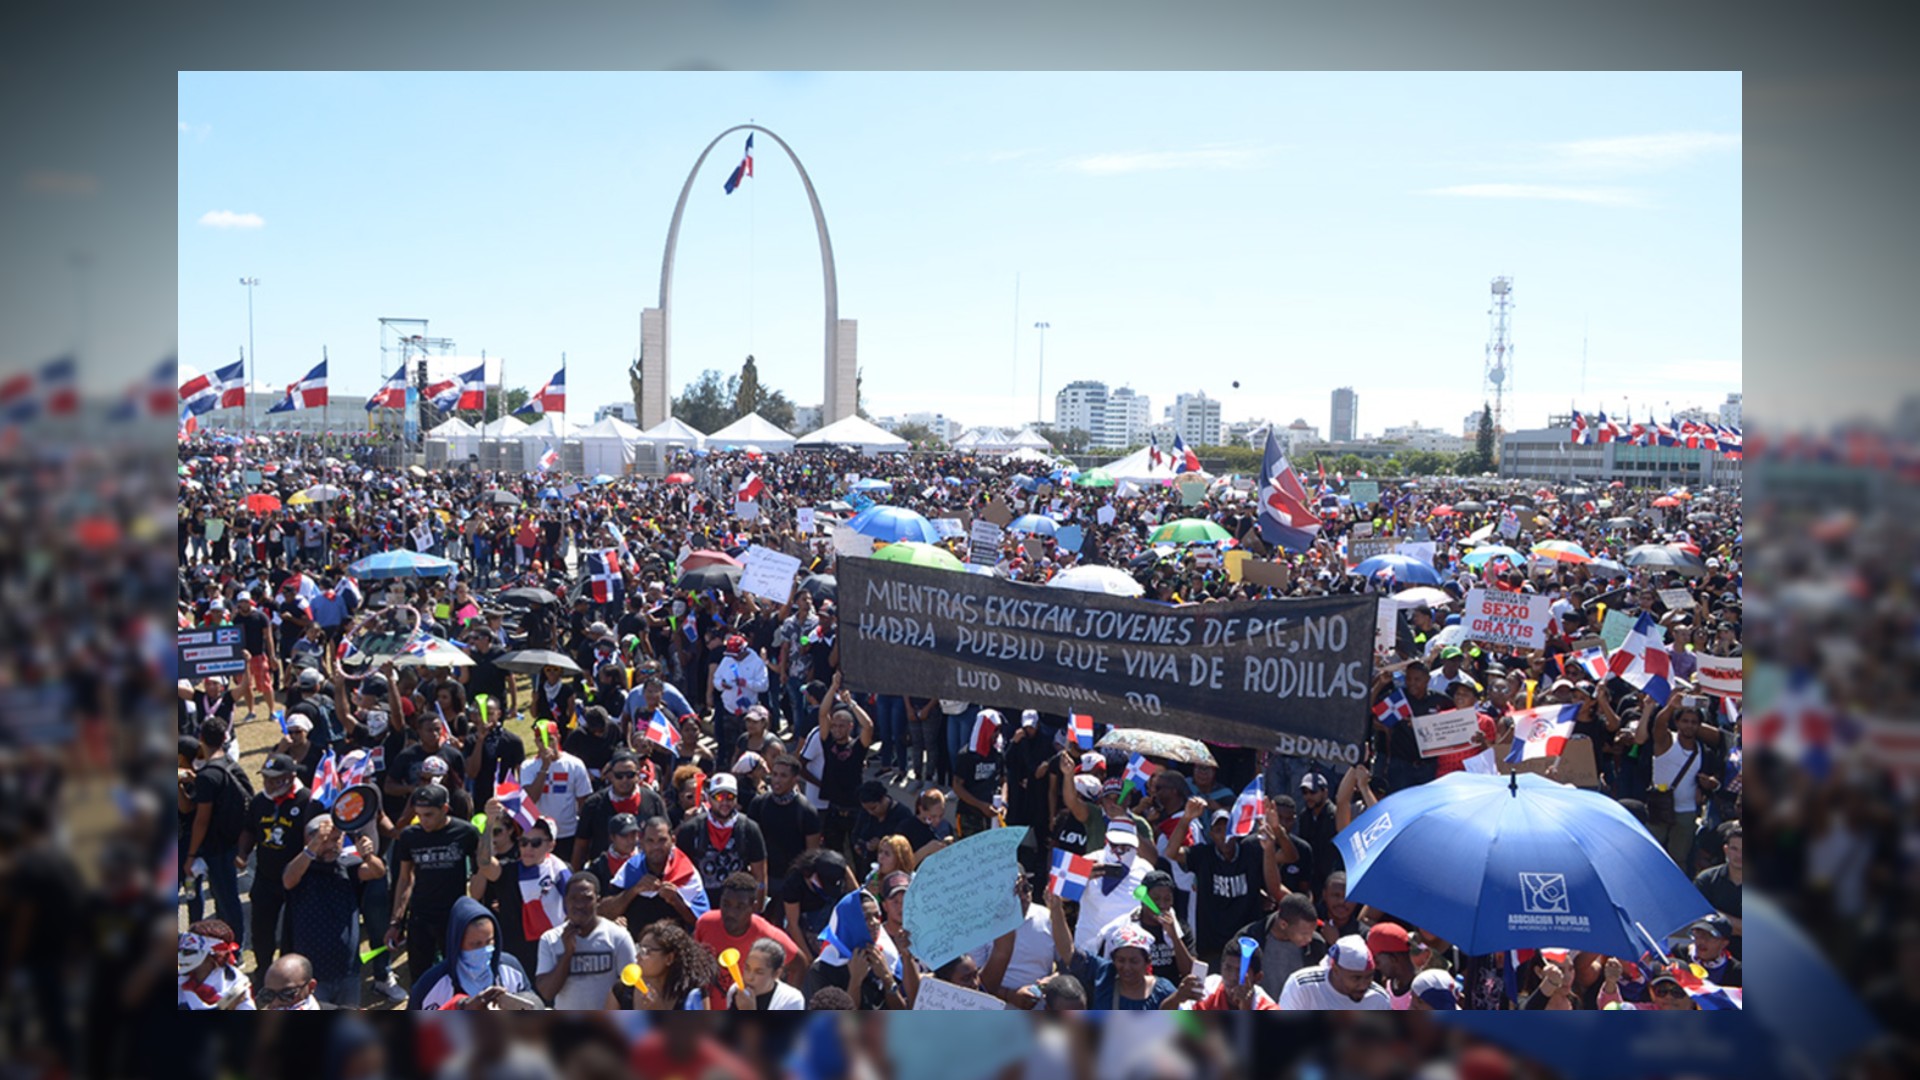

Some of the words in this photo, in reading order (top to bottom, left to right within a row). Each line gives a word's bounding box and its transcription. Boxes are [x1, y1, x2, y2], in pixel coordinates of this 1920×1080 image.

[865, 579, 979, 624] MIENTRAS
[984, 596, 1076, 633] EXISTAN
[1075, 609, 1195, 646] JOVENES
[1202, 618, 1241, 648] DE
[1481, 601, 1530, 620] SEXO
[1472, 619, 1534, 638] GRATIS
[858, 613, 936, 648] HABRA
[956, 625, 1045, 662] PUEBLO
[1056, 640, 1109, 673] QUE
[1122, 648, 1179, 683] VIVA
[1188, 653, 1224, 690] DE
[1243, 655, 1368, 700] RODILLAS
[956, 666, 1001, 692] LUTO
[1016, 678, 1107, 704] NACIONAL
[1275, 732, 1360, 764] BONAO
[1508, 914, 1554, 925] ASOCIACION
[1555, 915, 1590, 926] POPULAR
